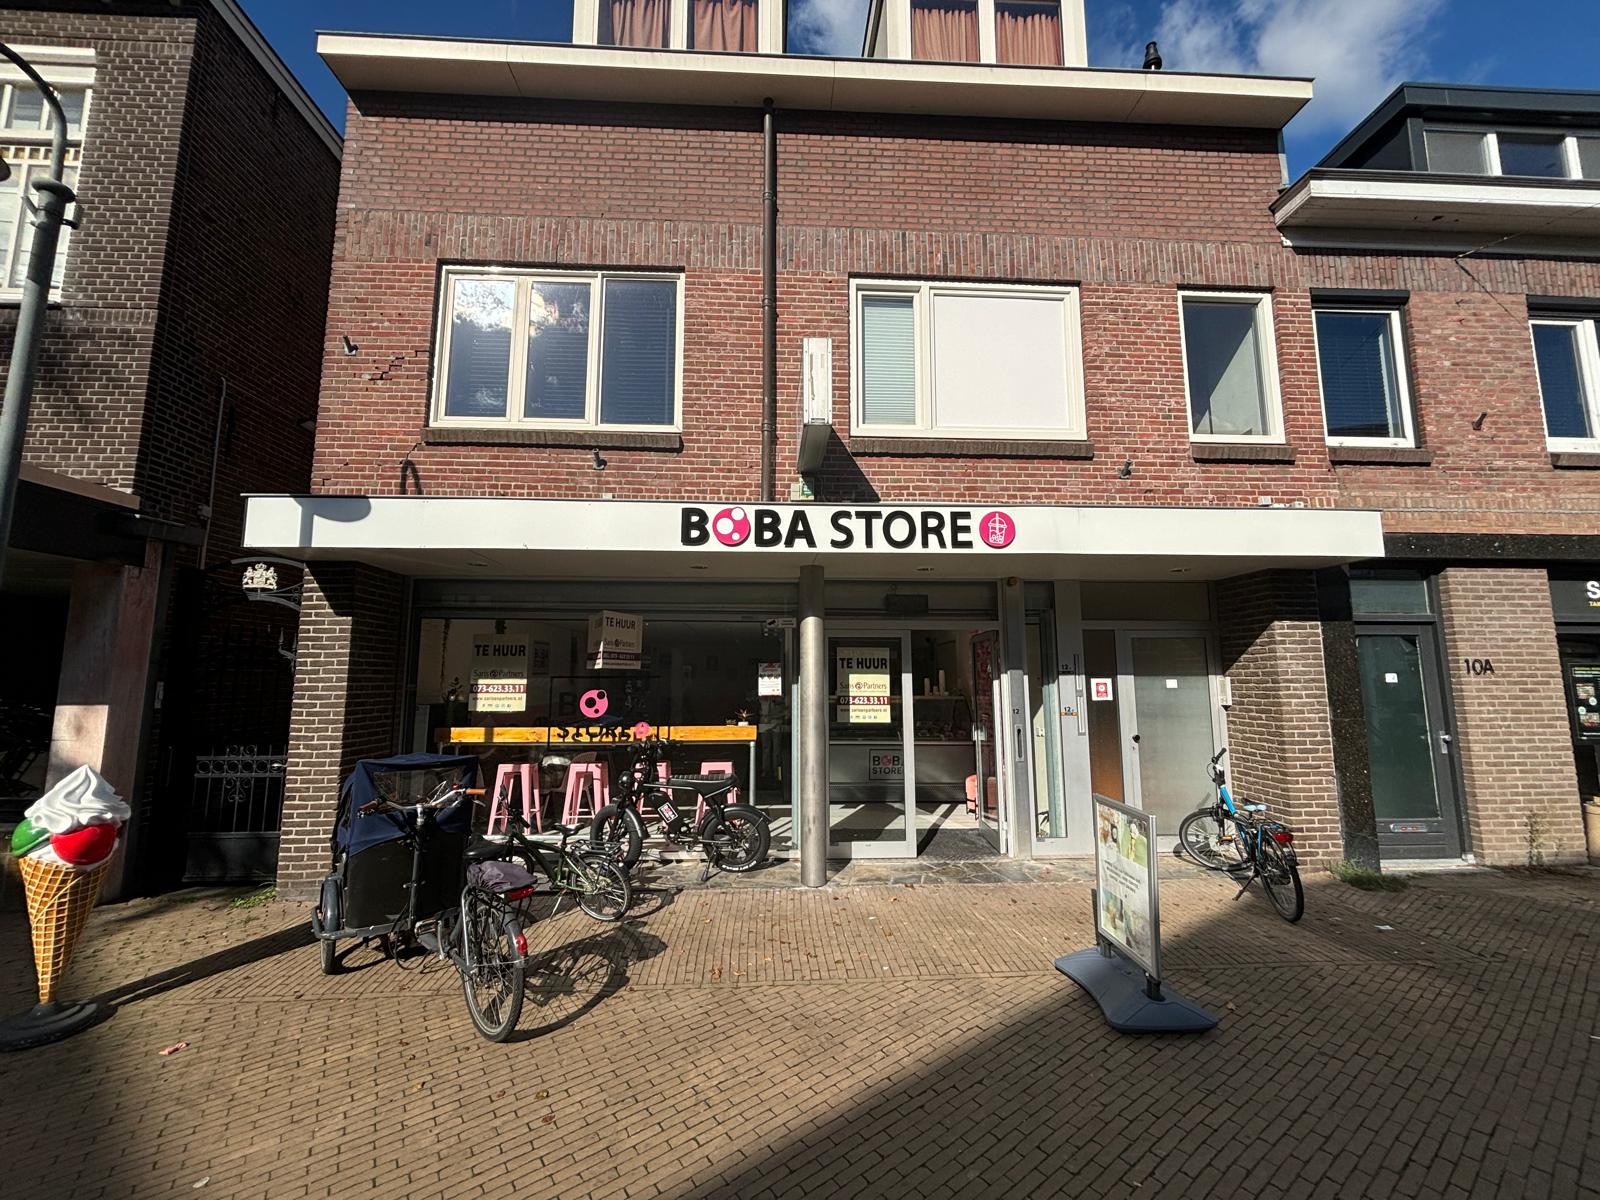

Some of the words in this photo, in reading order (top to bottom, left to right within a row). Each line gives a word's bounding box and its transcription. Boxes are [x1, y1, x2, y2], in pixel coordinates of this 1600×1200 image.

[680, 507, 816, 548] BOBA
[830, 509, 973, 549] STORE
[605, 616, 615, 627] TE
[615, 618, 636, 630] HUUR
[474, 644, 489, 656] TE
[492, 644, 526, 656] HUUR
[840, 657, 853, 669] TE
[856, 657, 887, 669] HUUR
[1464, 658, 1496, 675] 10A
[473, 684, 524, 692] 073-623.33.11
[863, 681, 887, 690] Partners
[840, 696, 888, 704] 073-623.33.11
[872, 753, 904, 767] BOB
[872, 766, 903, 775] STORE
